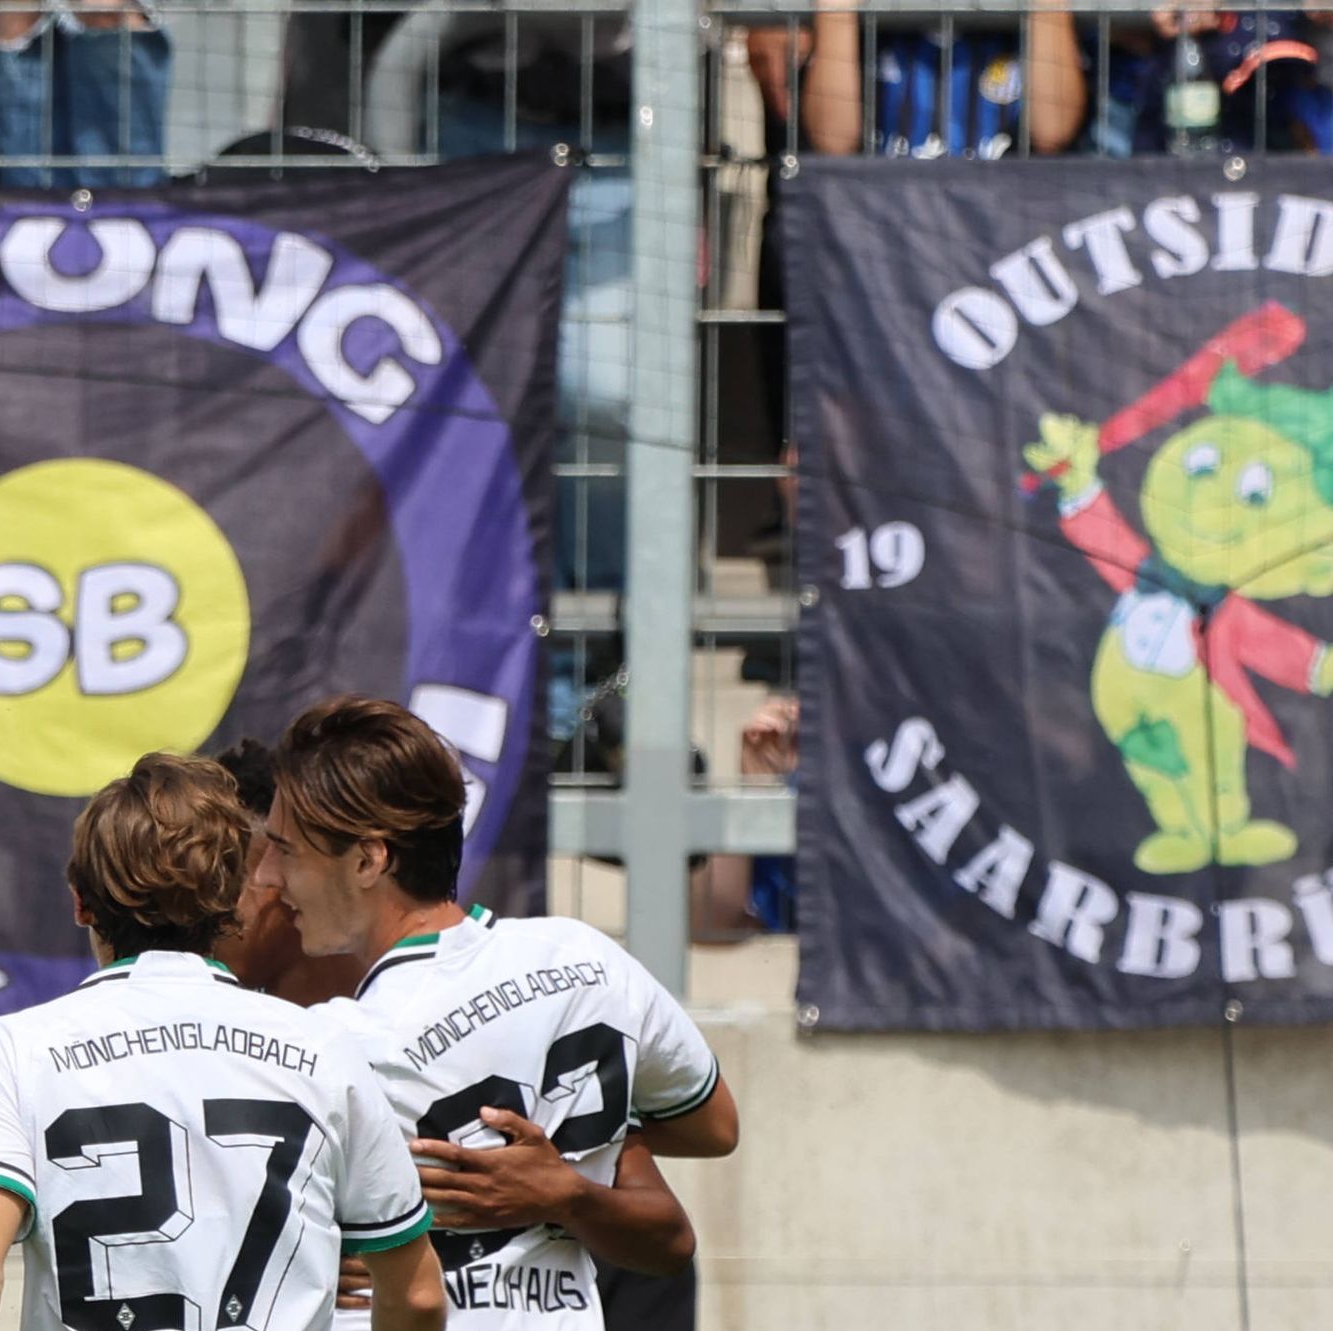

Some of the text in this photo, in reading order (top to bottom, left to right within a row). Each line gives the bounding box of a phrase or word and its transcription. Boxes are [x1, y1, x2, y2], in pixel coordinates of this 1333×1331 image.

[834, 521, 926, 591] 19
[48, 1021, 318, 1077] MÖNCHENGLADBACH
[403, 961, 608, 1073] MÖNCHENGLADBACH
